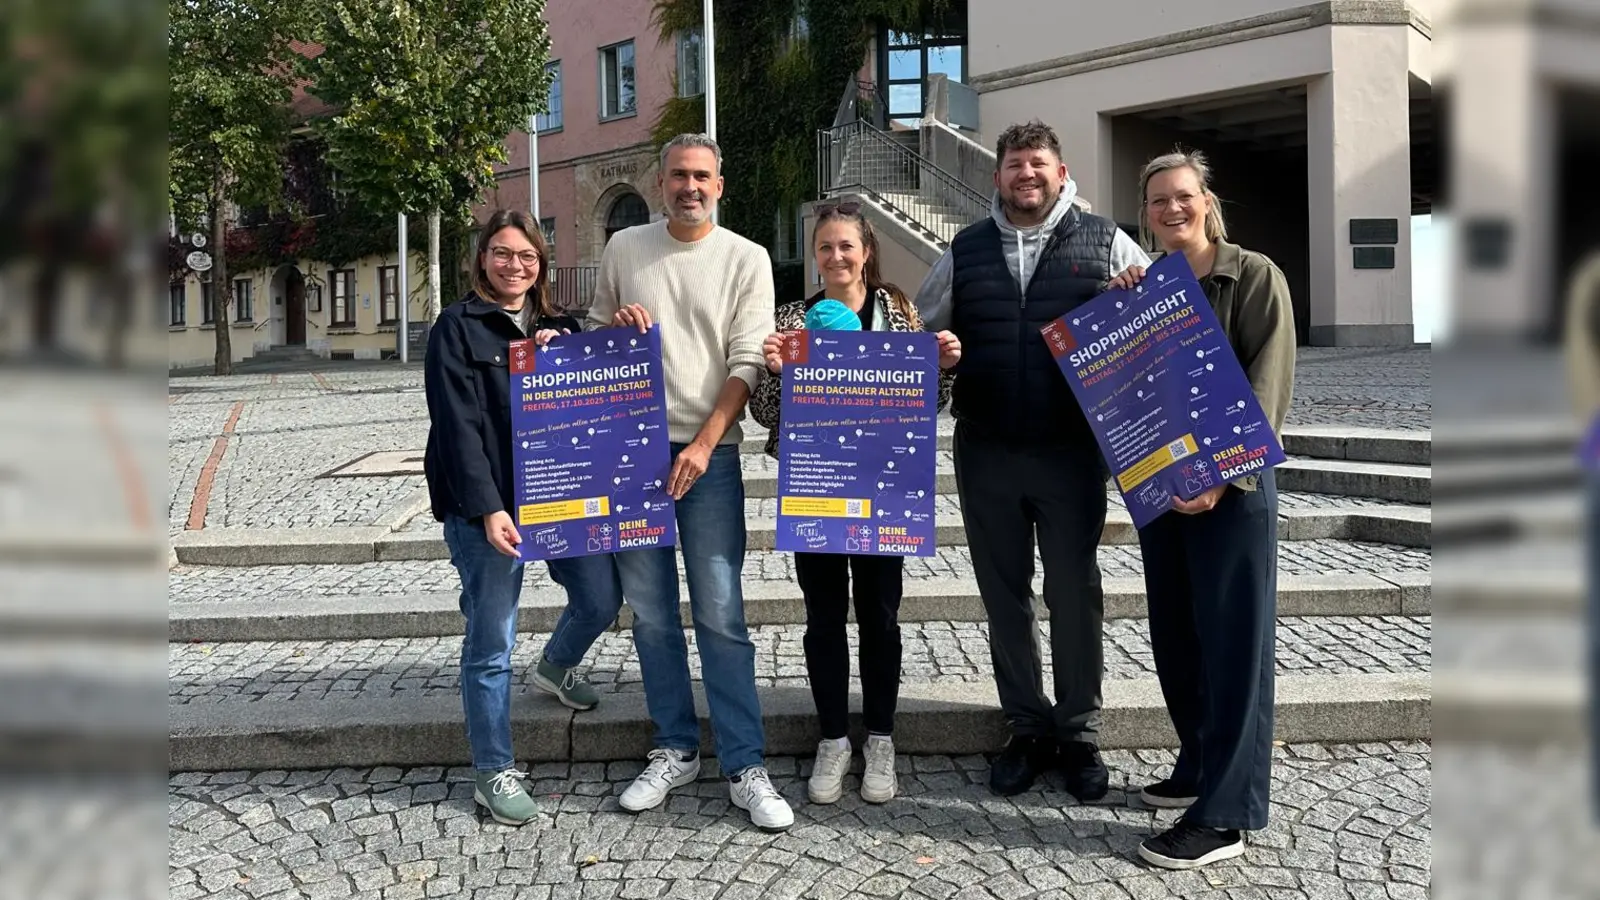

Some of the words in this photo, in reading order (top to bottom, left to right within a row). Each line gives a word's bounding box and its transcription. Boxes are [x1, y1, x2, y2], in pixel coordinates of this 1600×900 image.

[601, 163, 637, 177] RATHAUS
[1070, 290, 1186, 366] SHOPPINGNIGHT
[1077, 368, 1088, 379] IN
[1088, 358, 1107, 373] DER
[1106, 330, 1150, 363] DACHAUER
[1151, 305, 1194, 334] ALTSTADT
[1082, 367, 1115, 388] FREITAG,
[1115, 342, 1152, 369] 17.10.2025
[1156, 332, 1170, 343] BIS
[1170, 325, 1181, 335] 22
[1181, 316, 1201, 328] UHR
[523, 363, 649, 388] SHOPPINGNIGHT
[794, 368, 924, 383] SHOPPINGNIGHT
[522, 393, 532, 402] IN
[535, 391, 554, 400] DER
[556, 386, 606, 398] DACHAUER
[607, 380, 651, 392] ALTSTADT
[793, 385, 803, 393] IN
[805, 385, 824, 394] DER
[826, 386, 877, 395] DACHAUER
[878, 388, 924, 396] ALTSTADT
[523, 402, 559, 411] FREITAG,
[561, 397, 604, 408] 17.10.2025
[610, 394, 623, 402] BIS
[635, 391, 653, 399] UHR
[793, 396, 829, 405] FREITAG,
[831, 398, 874, 406] 17.10.2025
[1213, 444, 1246, 462] DEINE
[1218, 446, 1267, 470] ALTSTADT
[548, 462, 592, 470] Altstadtführungen
[1221, 457, 1264, 479] DACHAU
[619, 519, 647, 530] DEINE
[878, 526, 907, 535] DEINE
[620, 527, 665, 538] ALTSTADT
[879, 535, 924, 544] ALTSTADT
[620, 536, 658, 548] DACHAU
[878, 544, 917, 553] DACHAU
